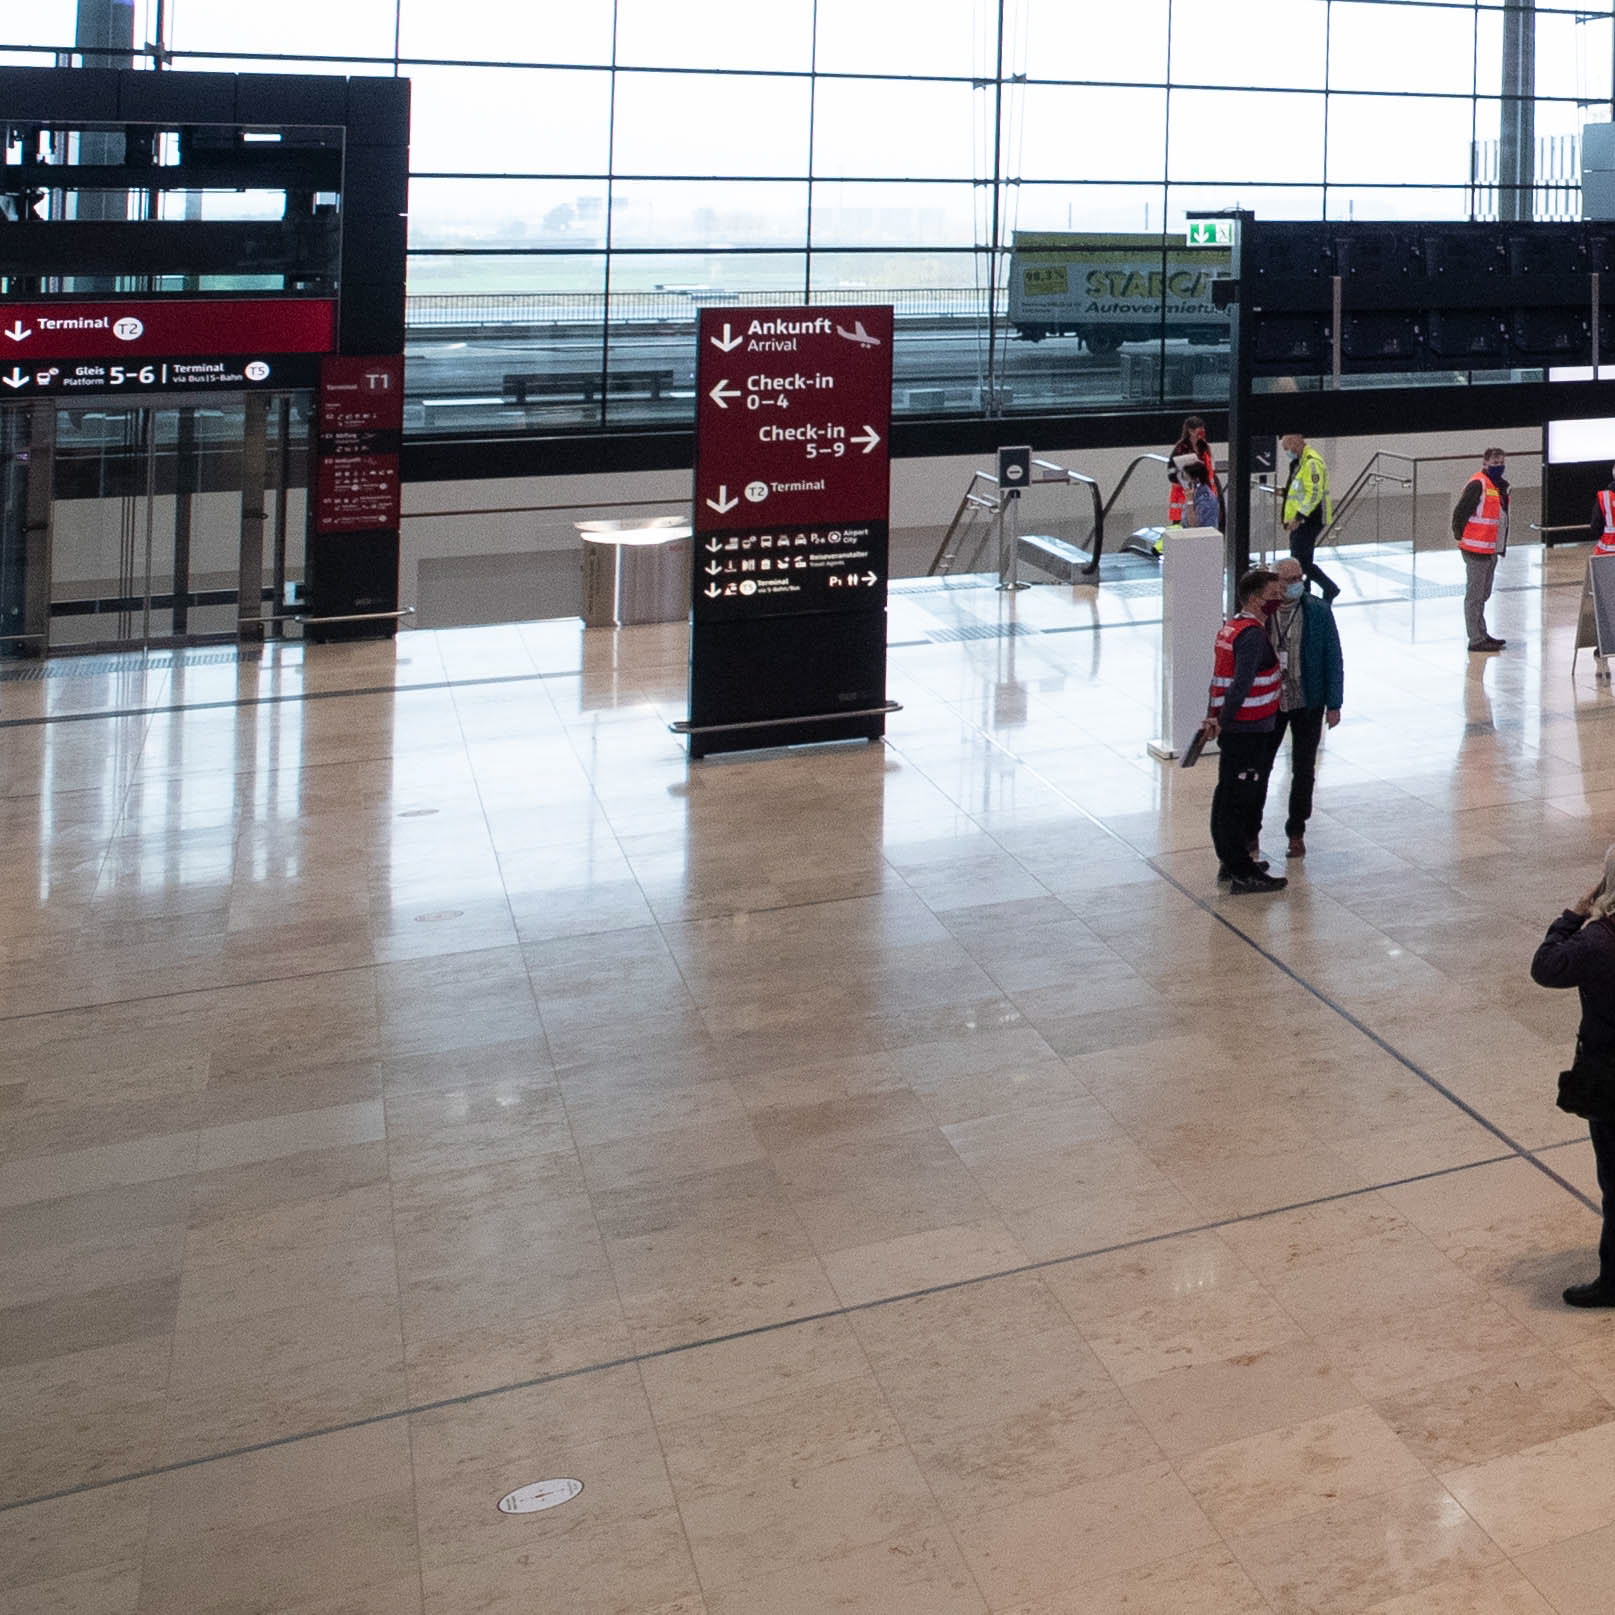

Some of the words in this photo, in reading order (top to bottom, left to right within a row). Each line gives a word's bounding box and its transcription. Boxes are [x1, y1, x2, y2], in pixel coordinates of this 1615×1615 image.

[1085, 270, 1232, 299] STARCA
[1085, 301, 1232, 317] Autovermietug
[37, 316, 110, 330] Terminal
[117, 322, 138, 335] T2
[748, 317, 832, 335] Ankunft
[747, 338, 797, 352] Arrival
[75, 366, 104, 376] Gleis
[110, 365, 154, 384] 5-6
[173, 364, 224, 374] Terminal
[250, 366, 266, 376] T5
[63, 377, 104, 386] Platform
[365, 374, 389, 390] T1
[747, 372, 834, 391] Check-in
[759, 423, 845, 442] Check-in
[750, 486, 764, 497] T2
[770, 479, 825, 492] Terminal
[842, 536, 858, 544] City
[843, 528, 869, 537] Airport
[757, 578, 789, 586] Terminal
